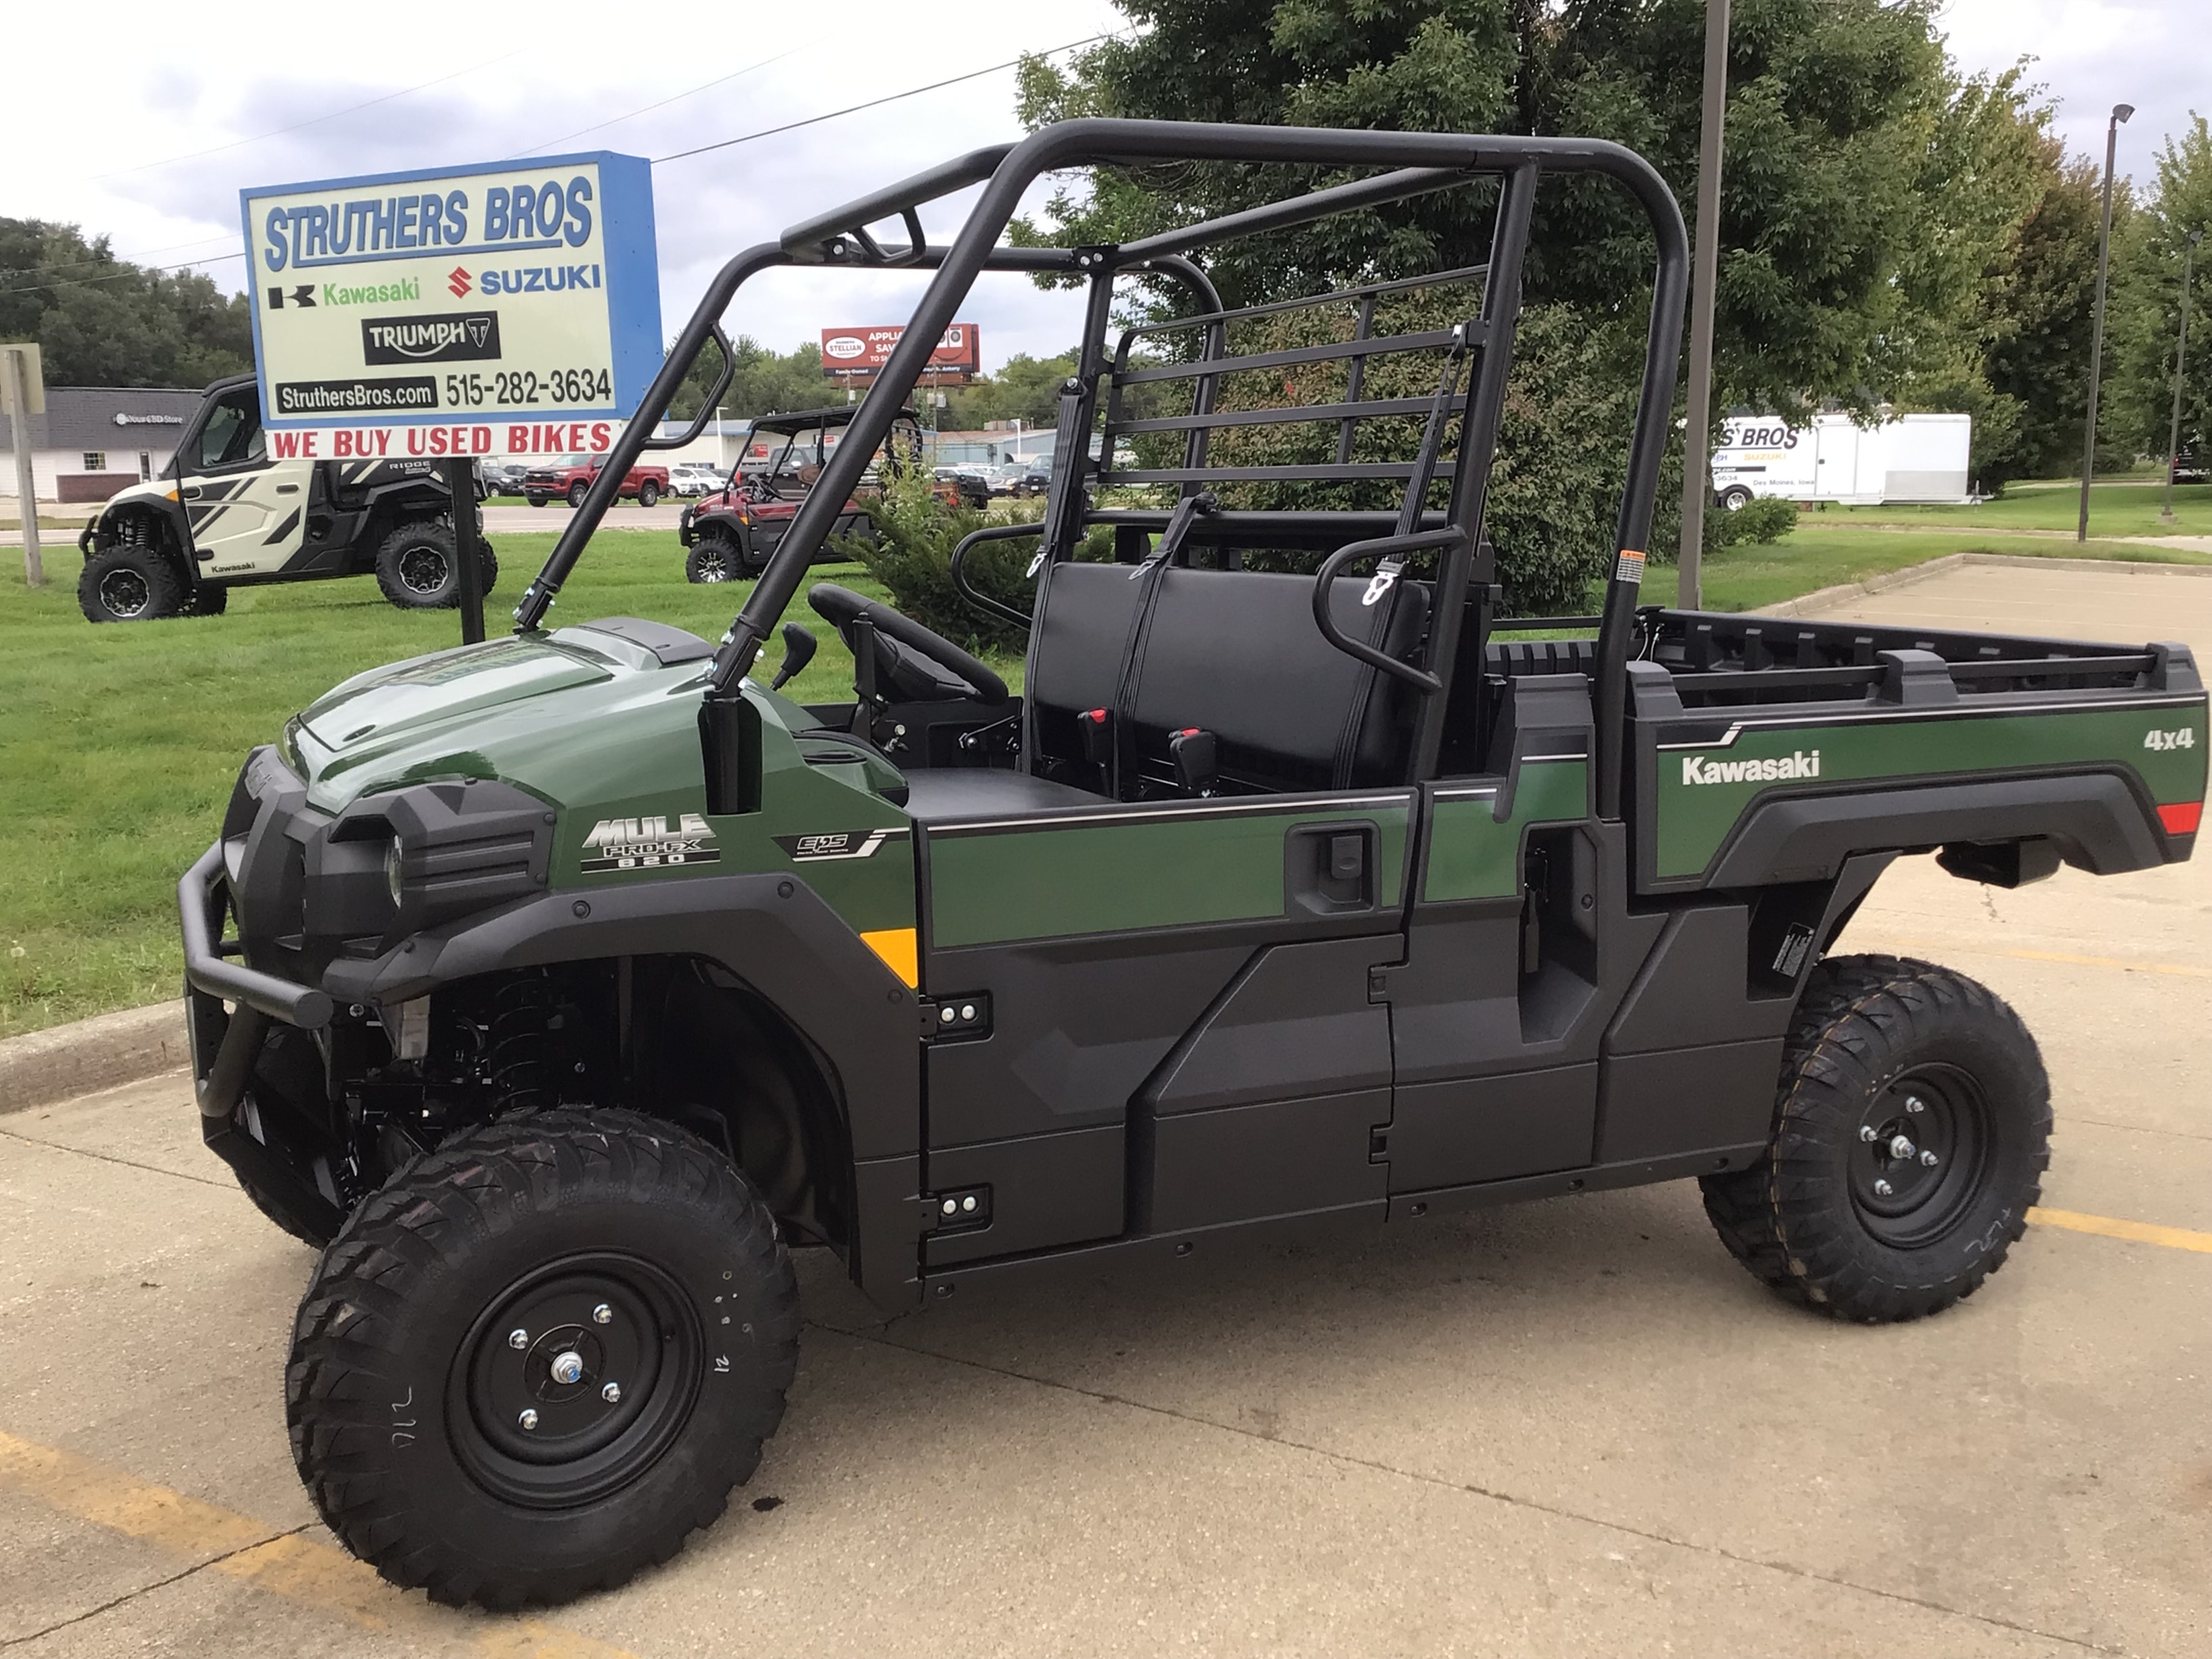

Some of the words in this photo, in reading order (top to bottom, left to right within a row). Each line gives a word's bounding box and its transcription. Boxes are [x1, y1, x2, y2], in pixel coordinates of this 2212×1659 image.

[265, 190, 468, 272] STRUTHERS
[484, 176, 593, 248] BROS
[323, 276, 420, 306] Kawasaki
[480, 264, 601, 295] SUZUKI
[369, 322, 466, 349] TRIUMPH
[868, 331, 903, 342] APPLIA
[876, 344, 896, 352] SAV
[282, 383, 432, 409] StruthersBros.com
[447, 368, 611, 406] 515-282-3634
[274, 432, 319, 458] WE
[334, 429, 392, 457] BUY
[407, 426, 492, 455] USED
[508, 422, 611, 453] BIKES
[1741, 428, 1800, 450] BROS
[1744, 453, 1786, 461] SUZUKI
[211, 562, 255, 573] Kawasaki
[2144, 727, 2195, 751] 4x4
[1683, 750, 1820, 785] Kawasaki
[581, 813, 717, 848] MULE
[797, 834, 848, 852] EPS
[617, 854, 685, 868] 820
